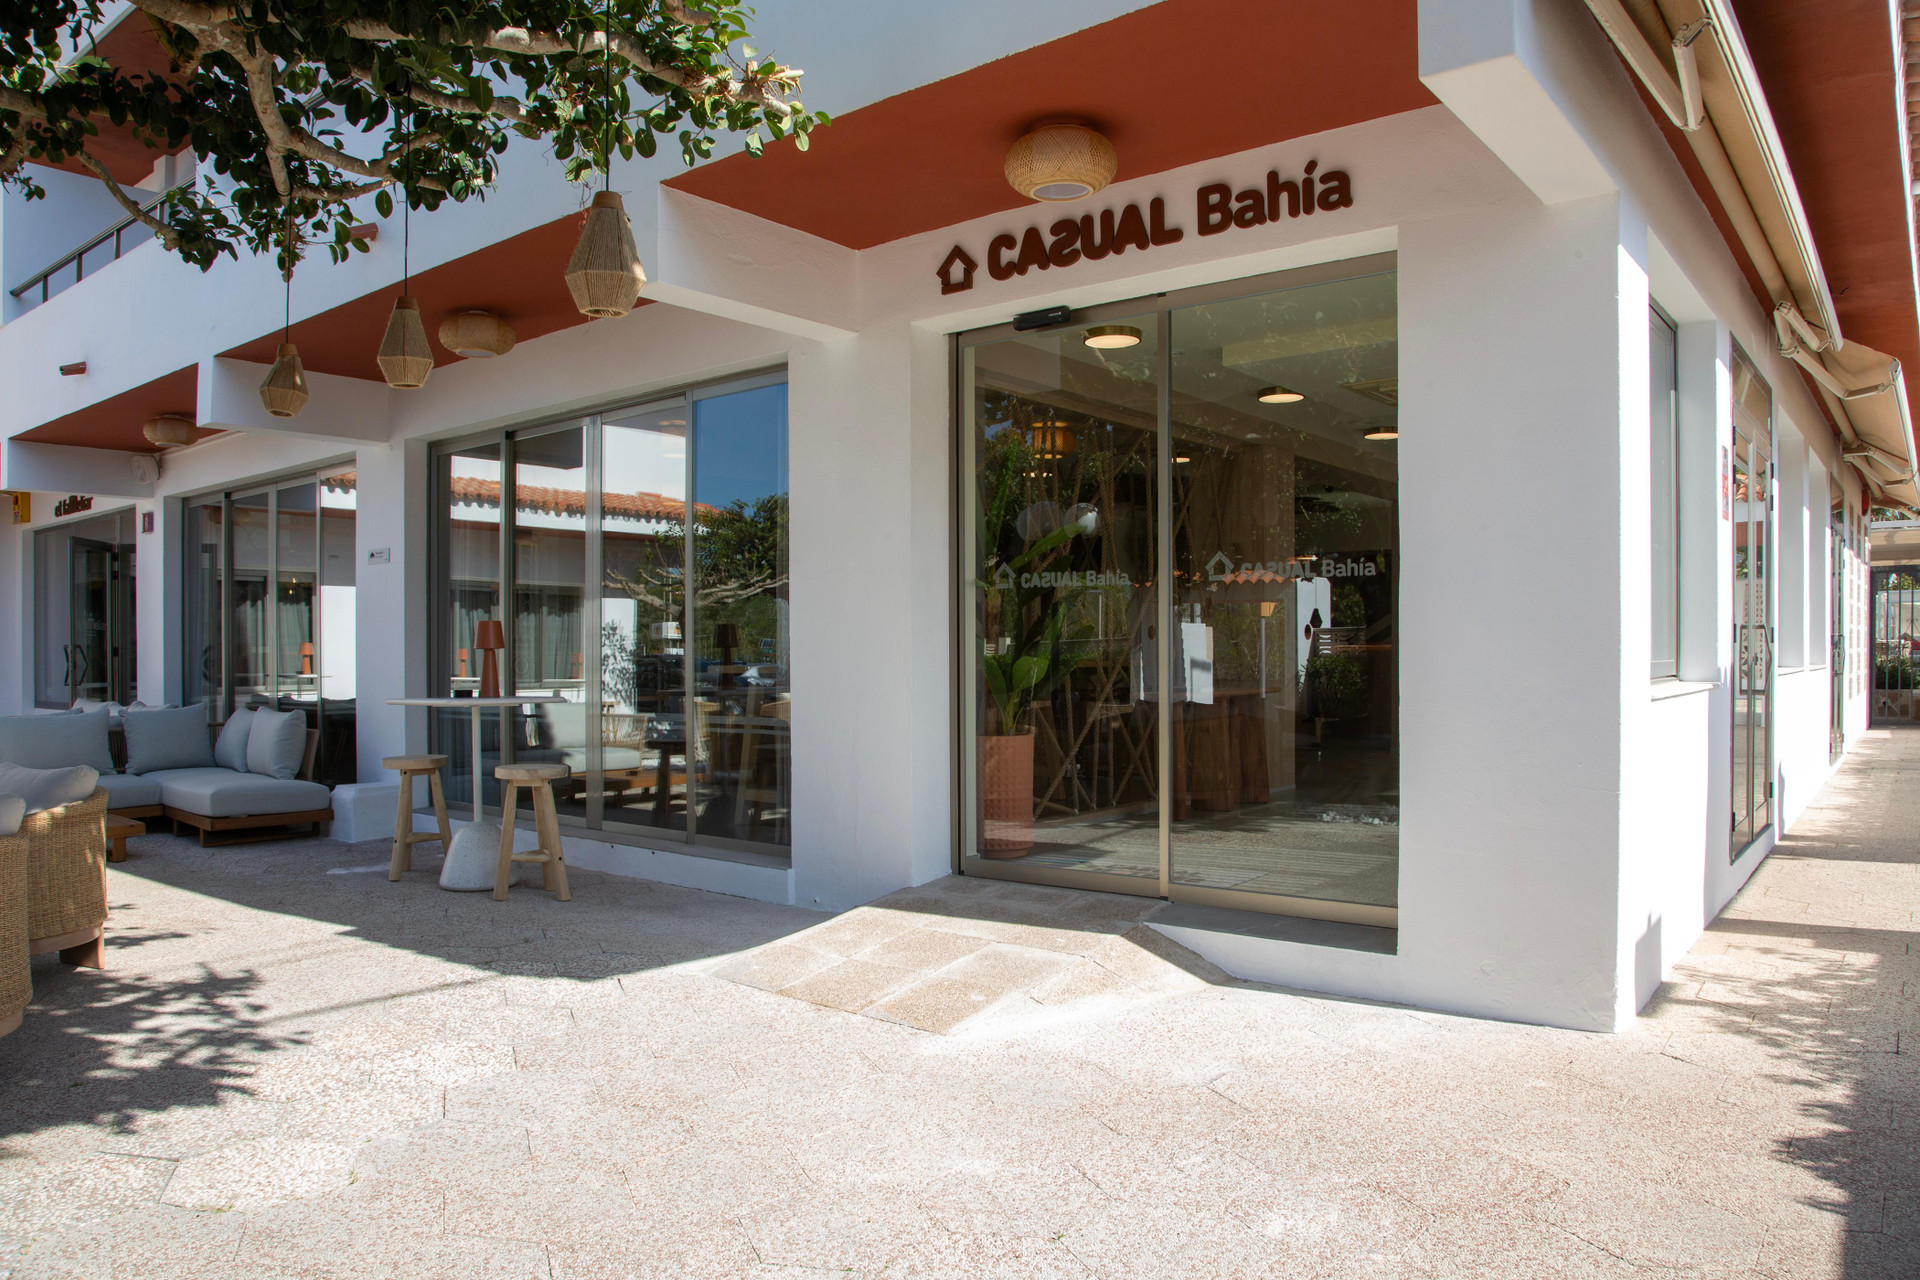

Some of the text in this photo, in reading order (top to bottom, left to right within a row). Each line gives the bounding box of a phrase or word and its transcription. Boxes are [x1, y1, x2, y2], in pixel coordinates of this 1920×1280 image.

[987, 159, 1354, 281] CASUAL Bahía
[1020, 568, 1129, 589] CASUAL Bahía
[1239, 557, 1377, 579] CASUAL Bahía
